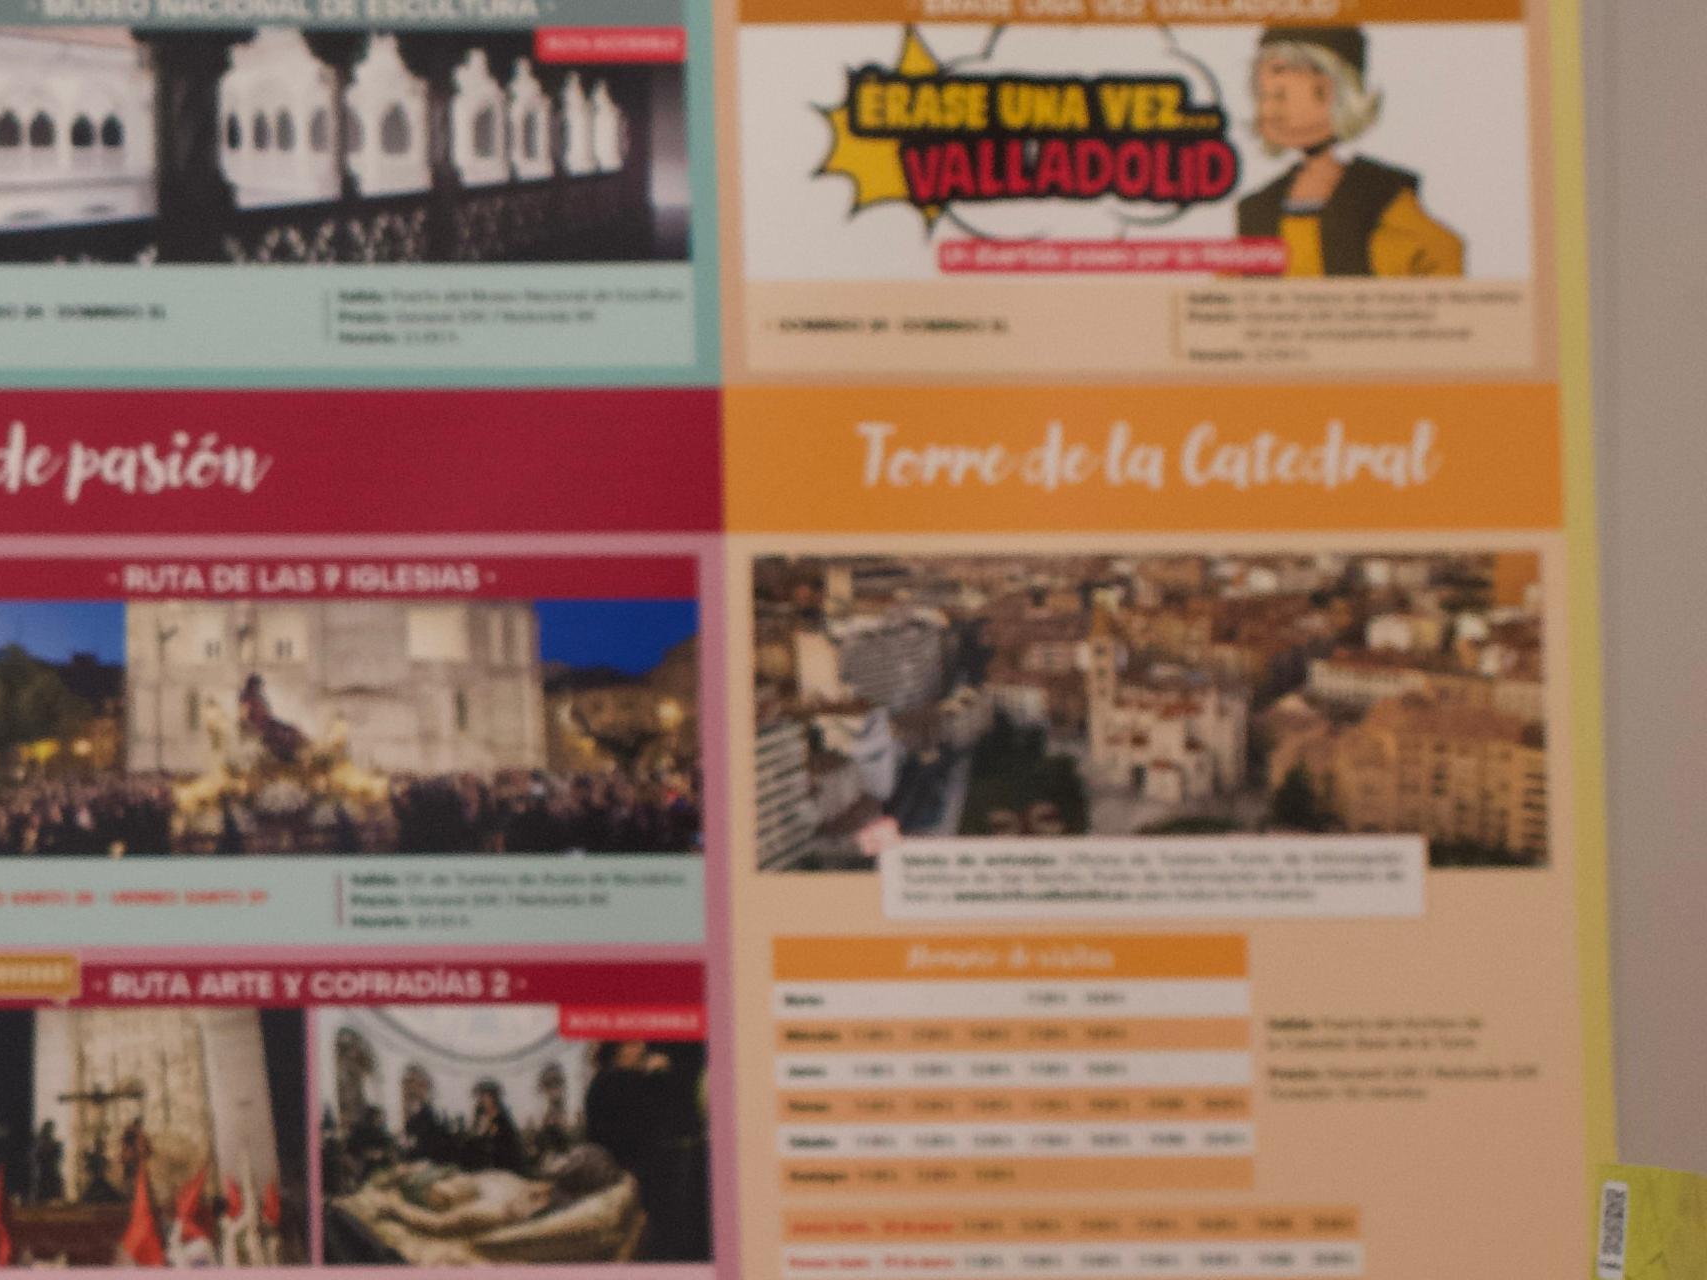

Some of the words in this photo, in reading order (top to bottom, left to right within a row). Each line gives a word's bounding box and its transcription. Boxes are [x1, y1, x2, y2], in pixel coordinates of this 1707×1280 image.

[857, 78, 989, 131] ÉRASE
[998, 81, 1089, 129] UNA
[903, 137, 1241, 203] VALLADOLID
[64, 428, 271, 504] pasión
[856, 420, 1007, 487] Torre
[1015, 421, 1099, 489] de
[1102, 421, 1163, 490] la
[1180, 419, 1442, 488] Catedral
[124, 565, 202, 593] RUTA
[212, 566, 251, 593] DE
[259, 566, 316, 593] LAS
[349, 566, 483, 594] IGLESIAS
[111, 970, 190, 999] RUTA
[199, 970, 274, 999] ARTE
[283, 970, 304, 998] Y
[310, 966, 483, 999] COFRADÍAS
[490, 969, 510, 997] 2
